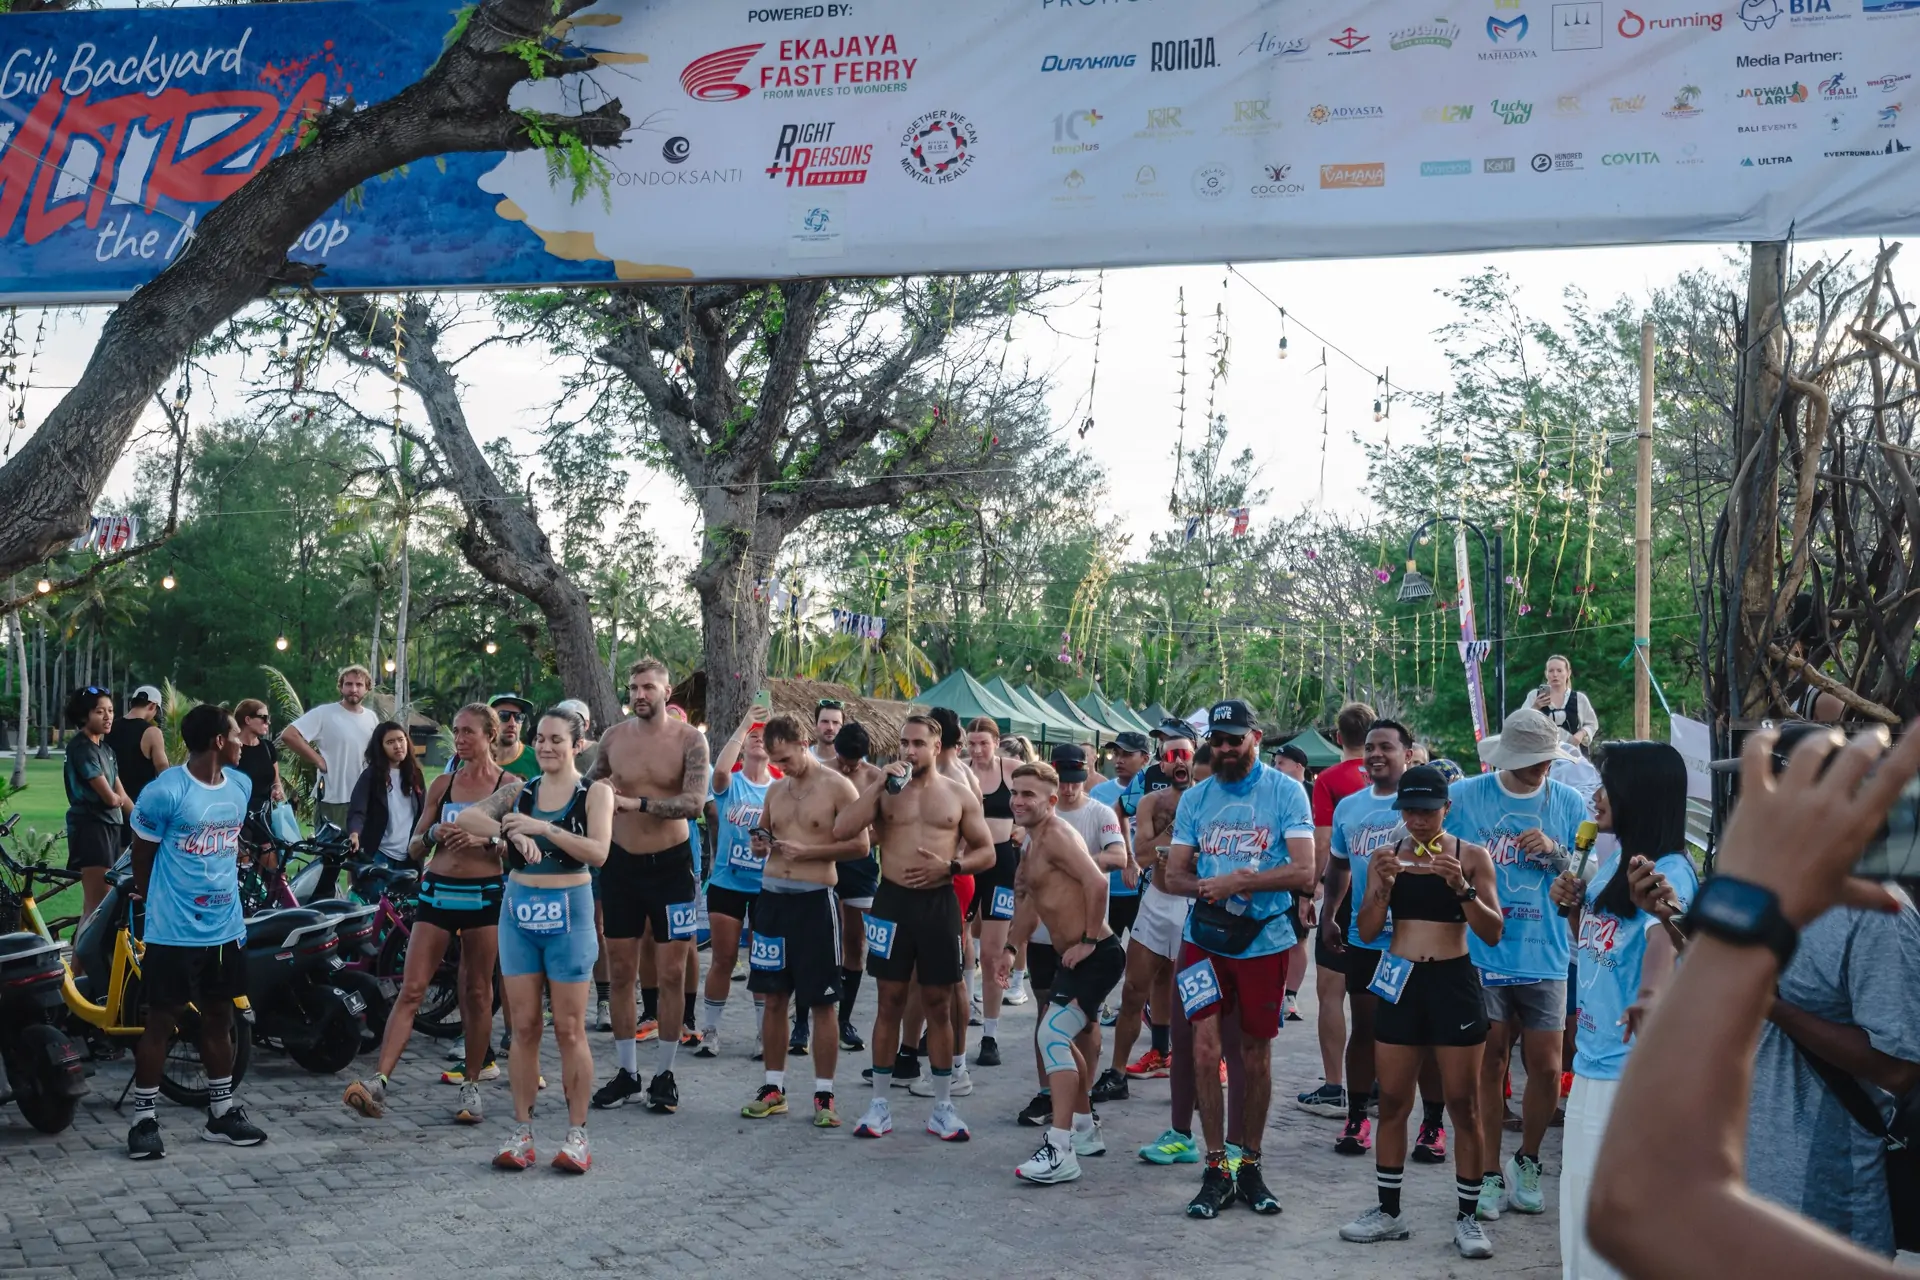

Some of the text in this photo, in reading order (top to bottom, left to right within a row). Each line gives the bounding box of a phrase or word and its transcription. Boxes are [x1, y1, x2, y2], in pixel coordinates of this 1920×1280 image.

[748, 4, 853, 23] POWERED BY:
[1649, 12, 1723, 32] running
[779, 34, 898, 62] EKAJAYA
[1477, 50, 1538, 61] MAHADAYA
[1736, 51, 1843, 68] Media Partner:
[1, 27, 252, 101] Gili Backyard
[760, 58, 918, 89] FAST FERRY
[1894, 73, 1912, 82] NEW
[763, 82, 908, 99] FROM WAVES TO WONDERS
[1736, 85, 1793, 98] JADWAL
[1828, 86, 1858, 96] BALI
[1757, 95, 1787, 105] LARI
[1332, 106, 1384, 117] ADYASTA
[1490, 98, 1533, 118] Lucky
[901, 110, 979, 148] TOGETHER WE CAN
[1737, 122, 1798, 133] BALI EVENTS
[775, 122, 836, 162] RIGHT
[1554, 152, 1583, 161] HUNDRED
[1601, 152, 1660, 166] COVITA
[1758, 155, 1793, 166] ULTRA
[900, 154, 977, 185] MENTAL HEALTH
[1554, 160, 1574, 168] SEEDS
[809, 172, 864, 186] FUNDING
[1250, 183, 1305, 195] COCOON
[96, 214, 160, 262] the
[1213, 711, 1232, 722] DIVE
[516, 902, 563, 922] 028
